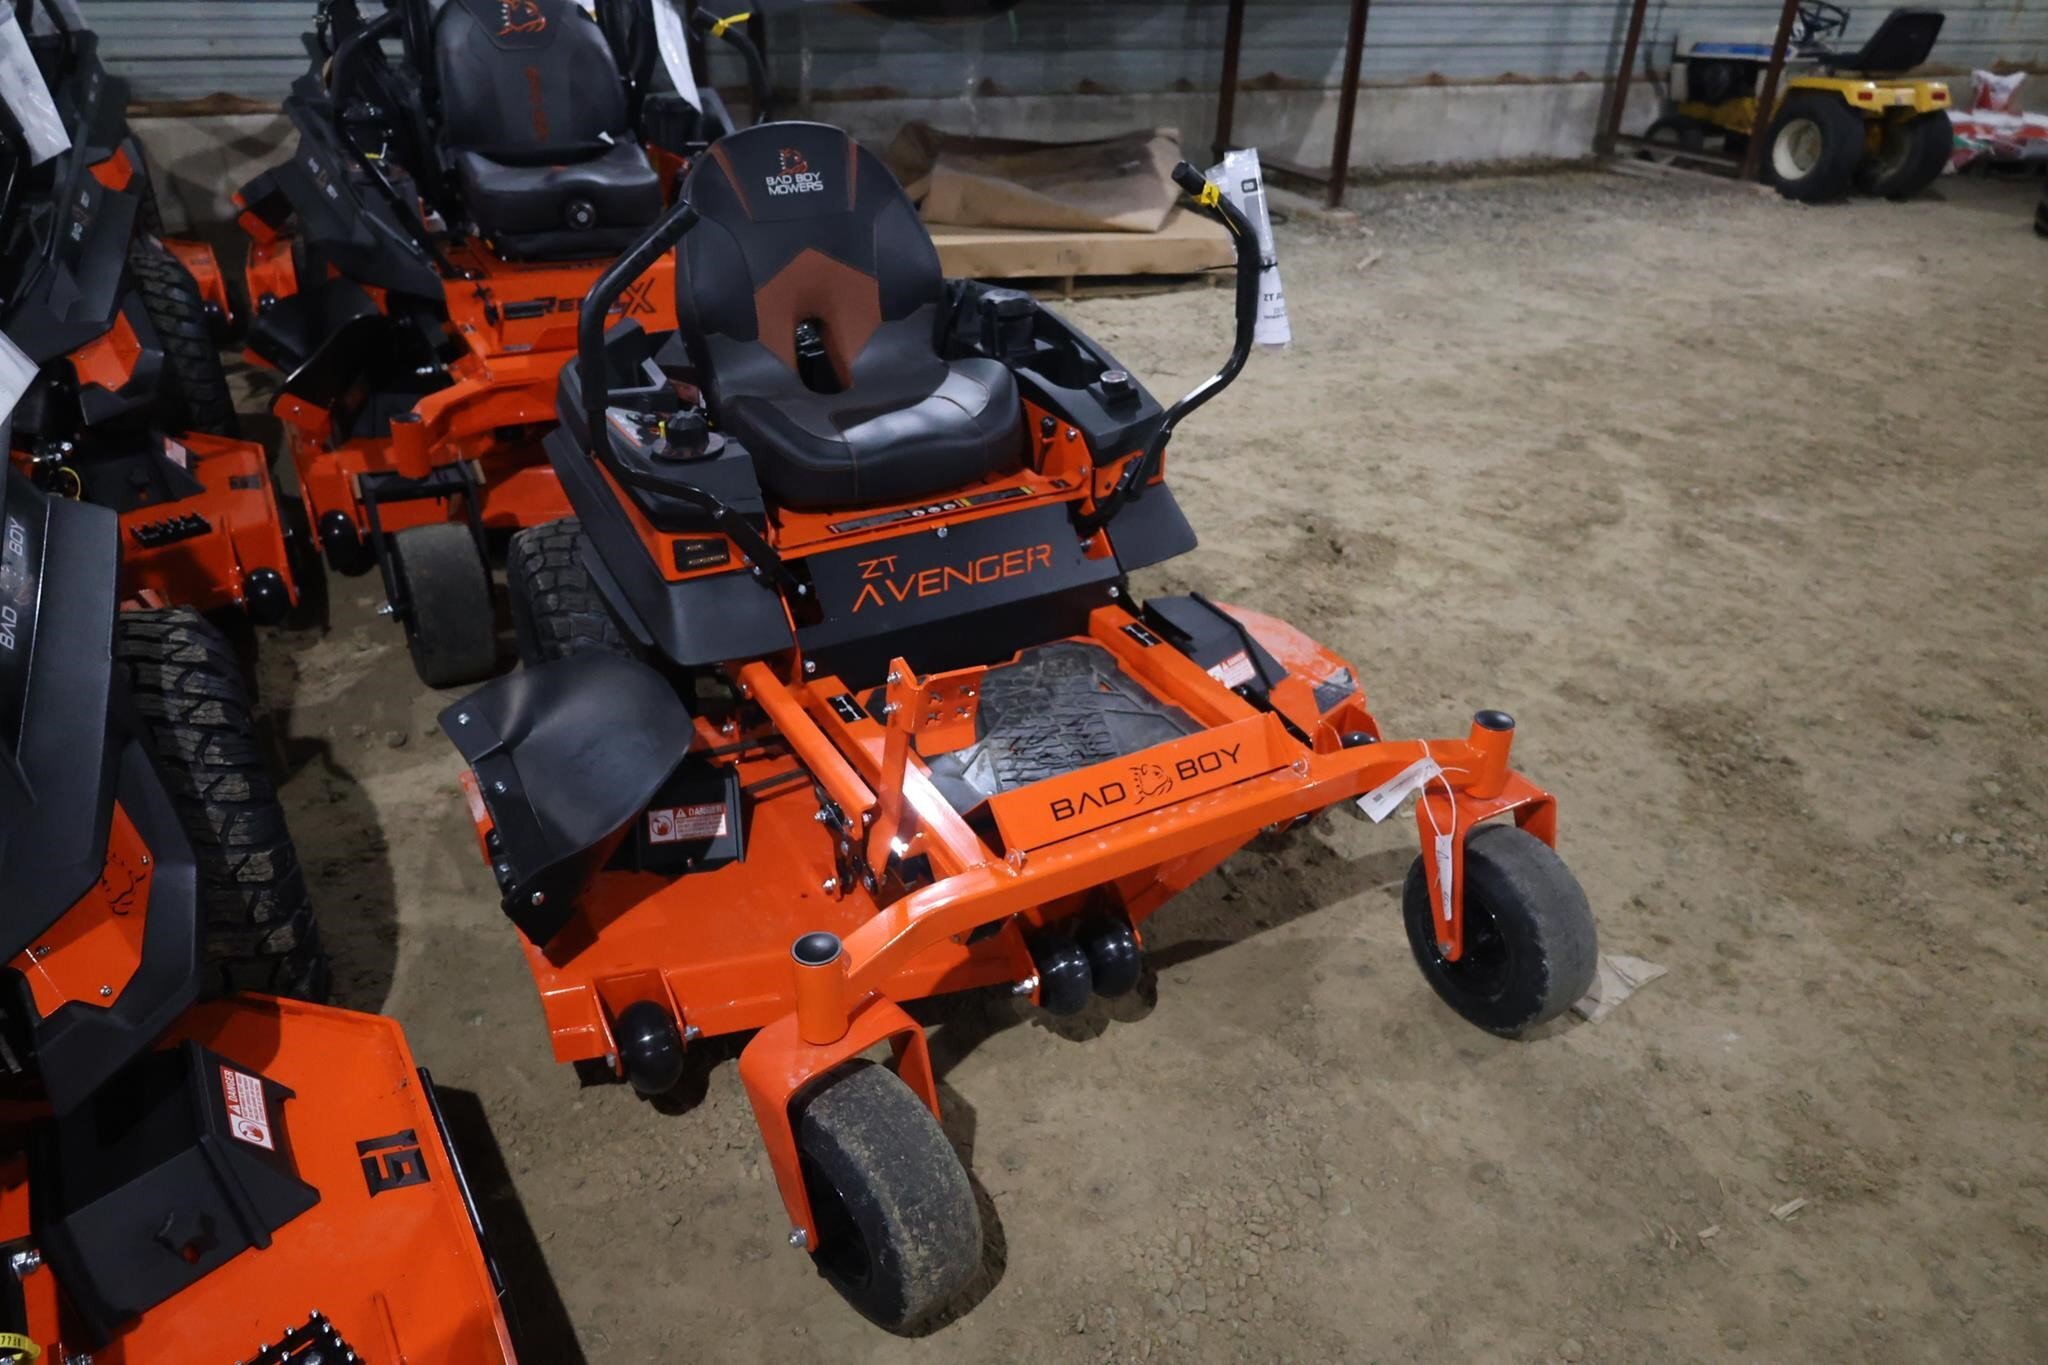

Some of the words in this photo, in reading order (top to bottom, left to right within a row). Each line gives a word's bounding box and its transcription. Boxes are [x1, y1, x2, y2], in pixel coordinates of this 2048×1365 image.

[766, 174, 792, 186] BAD
[795, 172, 820, 183] BOY
[768, 180, 824, 195] MOWERS
[0, 606, 18, 650] BAD
[9, 516, 27, 556] BOY
[852, 544, 1053, 613] AVENGER
[857, 554, 898, 580] ZT
[1050, 782, 1126, 822] BAD
[1175, 743, 1241, 781] BOY
[223, 1069, 239, 1102] DANGER
